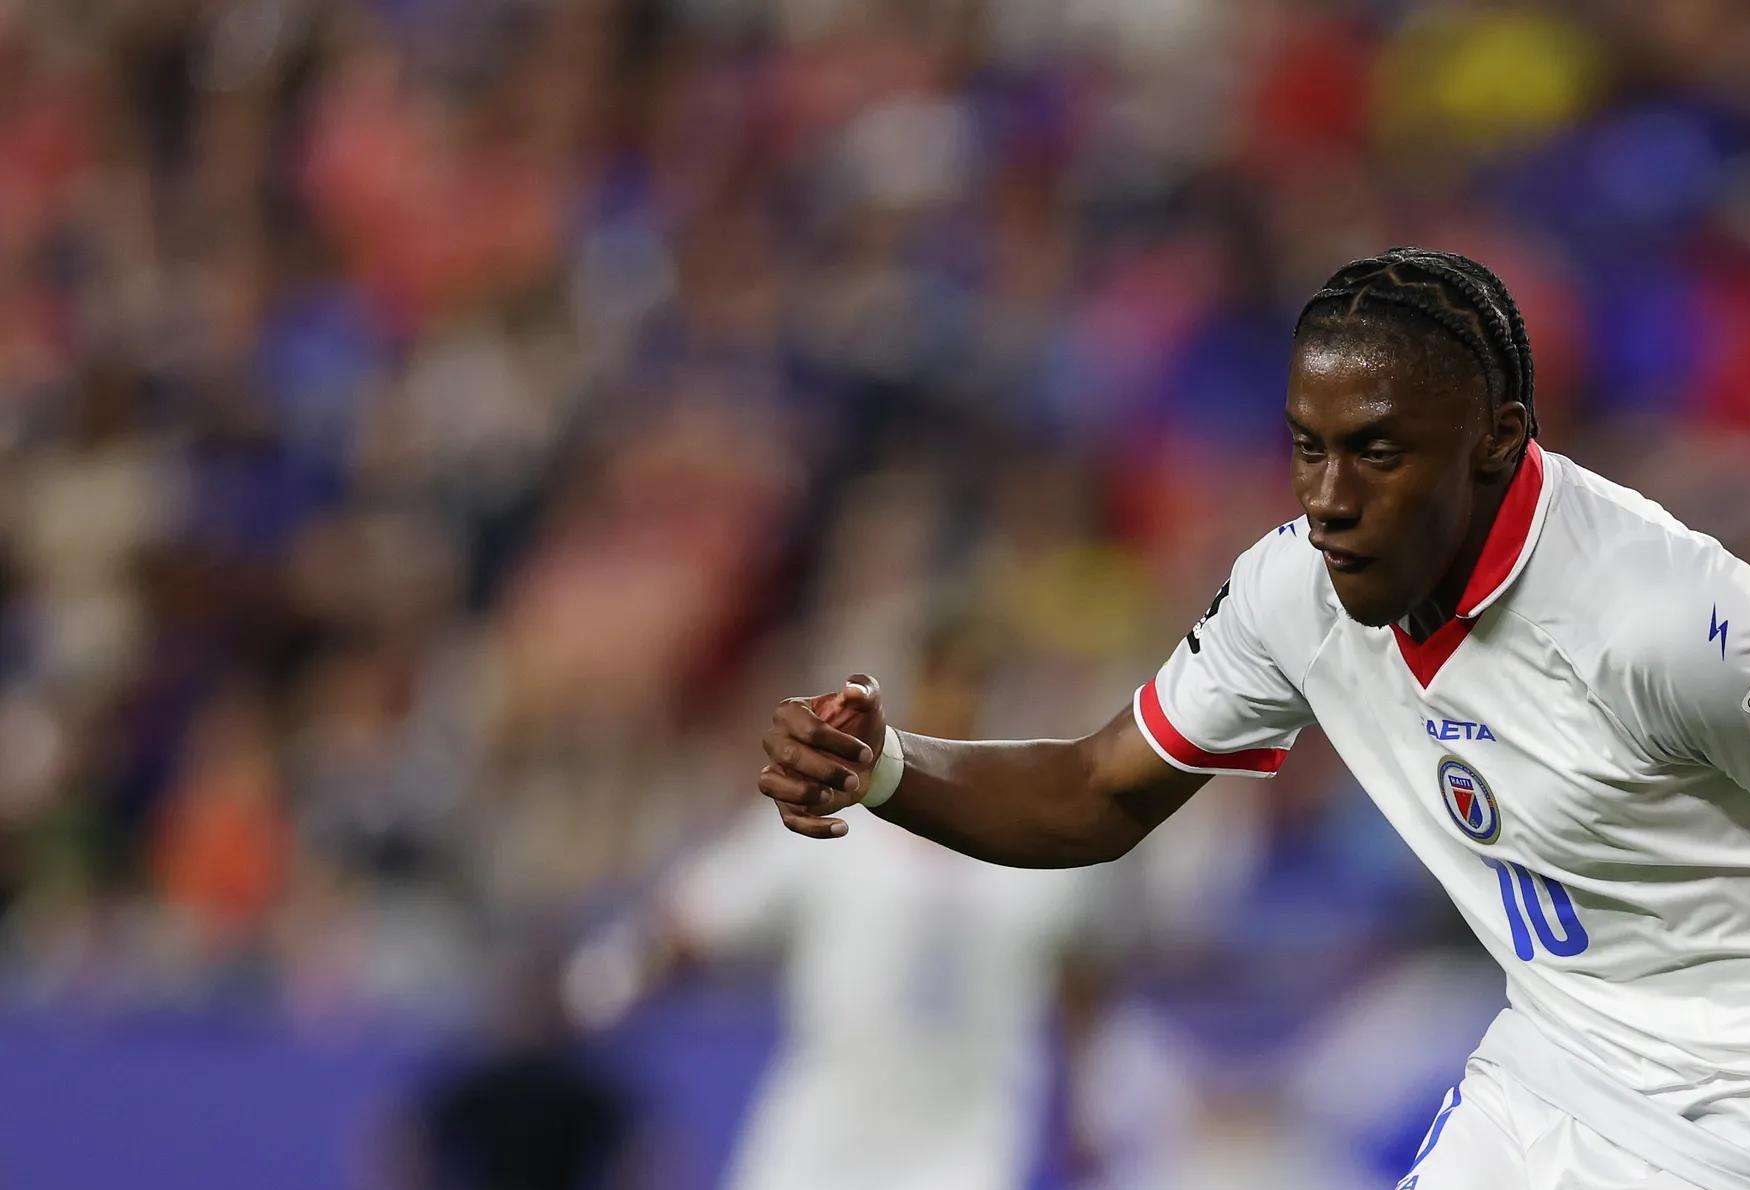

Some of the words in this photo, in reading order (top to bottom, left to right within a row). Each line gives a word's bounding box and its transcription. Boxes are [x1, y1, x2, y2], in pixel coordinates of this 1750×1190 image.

[1425, 719, 1497, 742] AETA
[1450, 776, 1473, 788] HAITI
[1480, 856, 1589, 962] 10
